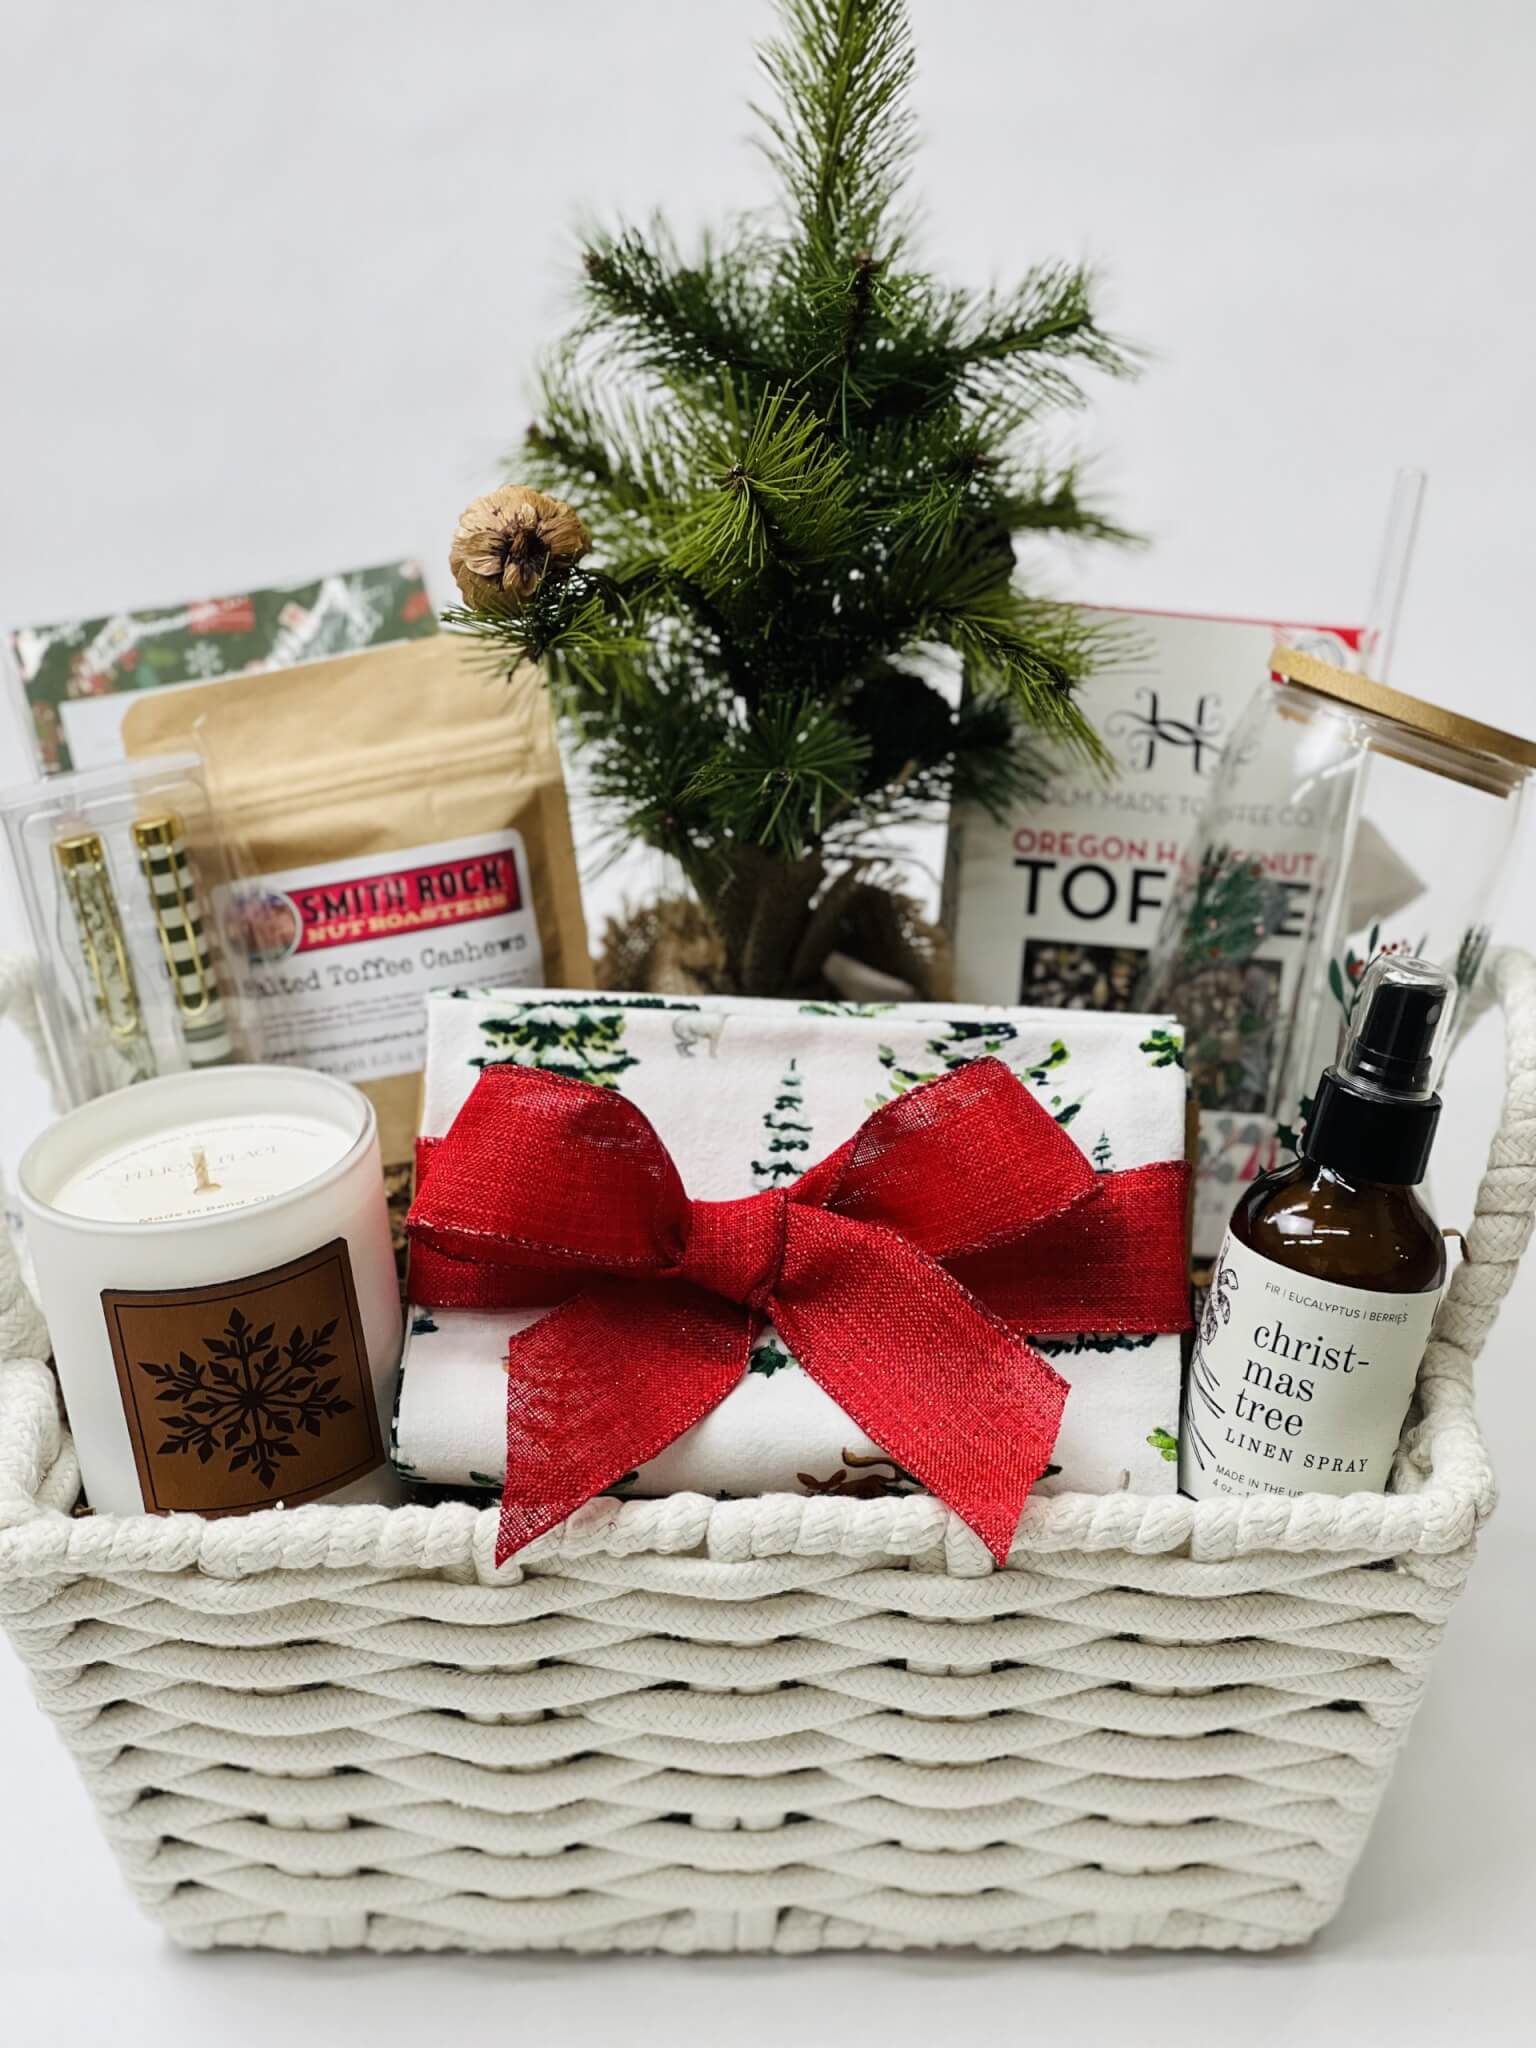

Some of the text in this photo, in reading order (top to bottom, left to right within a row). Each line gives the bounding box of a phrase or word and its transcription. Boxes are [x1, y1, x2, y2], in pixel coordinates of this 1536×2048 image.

[1012, 828, 1317, 877] OREGON HNUT
[303, 862, 500, 924] SMITH ROCK
[1013, 858, 1311, 937] TOFE
[307, 893, 508, 944] NUT ROASTERS
[326, 957, 413, 987] Toffee
[420, 934, 527, 970] Cashews
[1264, 1281, 1409, 1325] FIR EUCALYPTUS BERRIES
[1253, 1320, 1370, 1374] christ-
[1242, 1359, 1316, 1402] mas
[1234, 1388, 1304, 1437] tree
[1224, 1428, 1369, 1474] LINEN SPRAY
[1215, 1464, 1246, 1484] MADE
[1248, 1478, 1260, 1489] IN
[1263, 1482, 1286, 1496] THE
